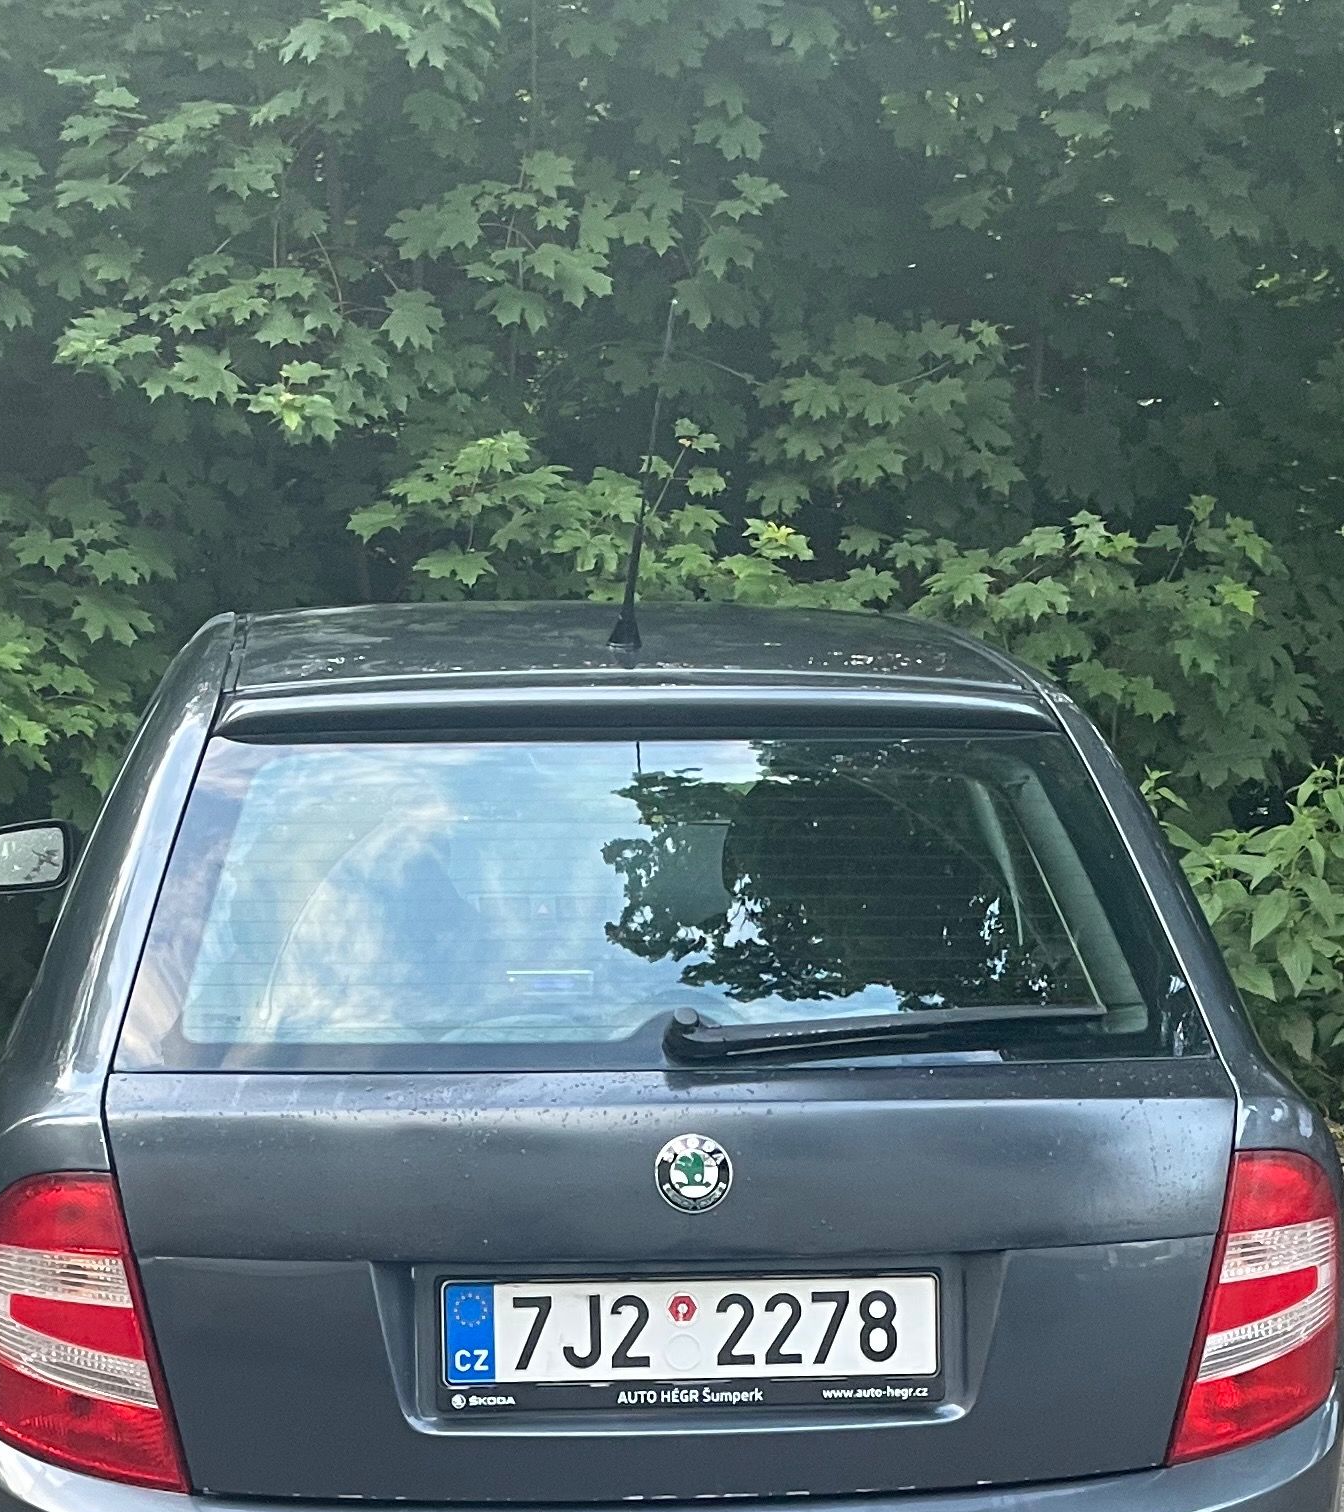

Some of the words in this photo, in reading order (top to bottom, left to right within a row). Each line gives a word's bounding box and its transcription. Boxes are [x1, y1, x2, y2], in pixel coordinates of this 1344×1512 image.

[513, 1294, 651, 1370] 7J2
[716, 1290, 898, 1365] 2278
[454, 1349, 489, 1372] CZ
[468, 1395, 516, 1406] ŠKODA
[617, 1390, 657, 1404] AUTO
[660, 1387, 699, 1403] HÉGR
[702, 1386, 764, 1405] Šumperk
[822, 1385, 929, 1400] www.auto-hegr.cz
